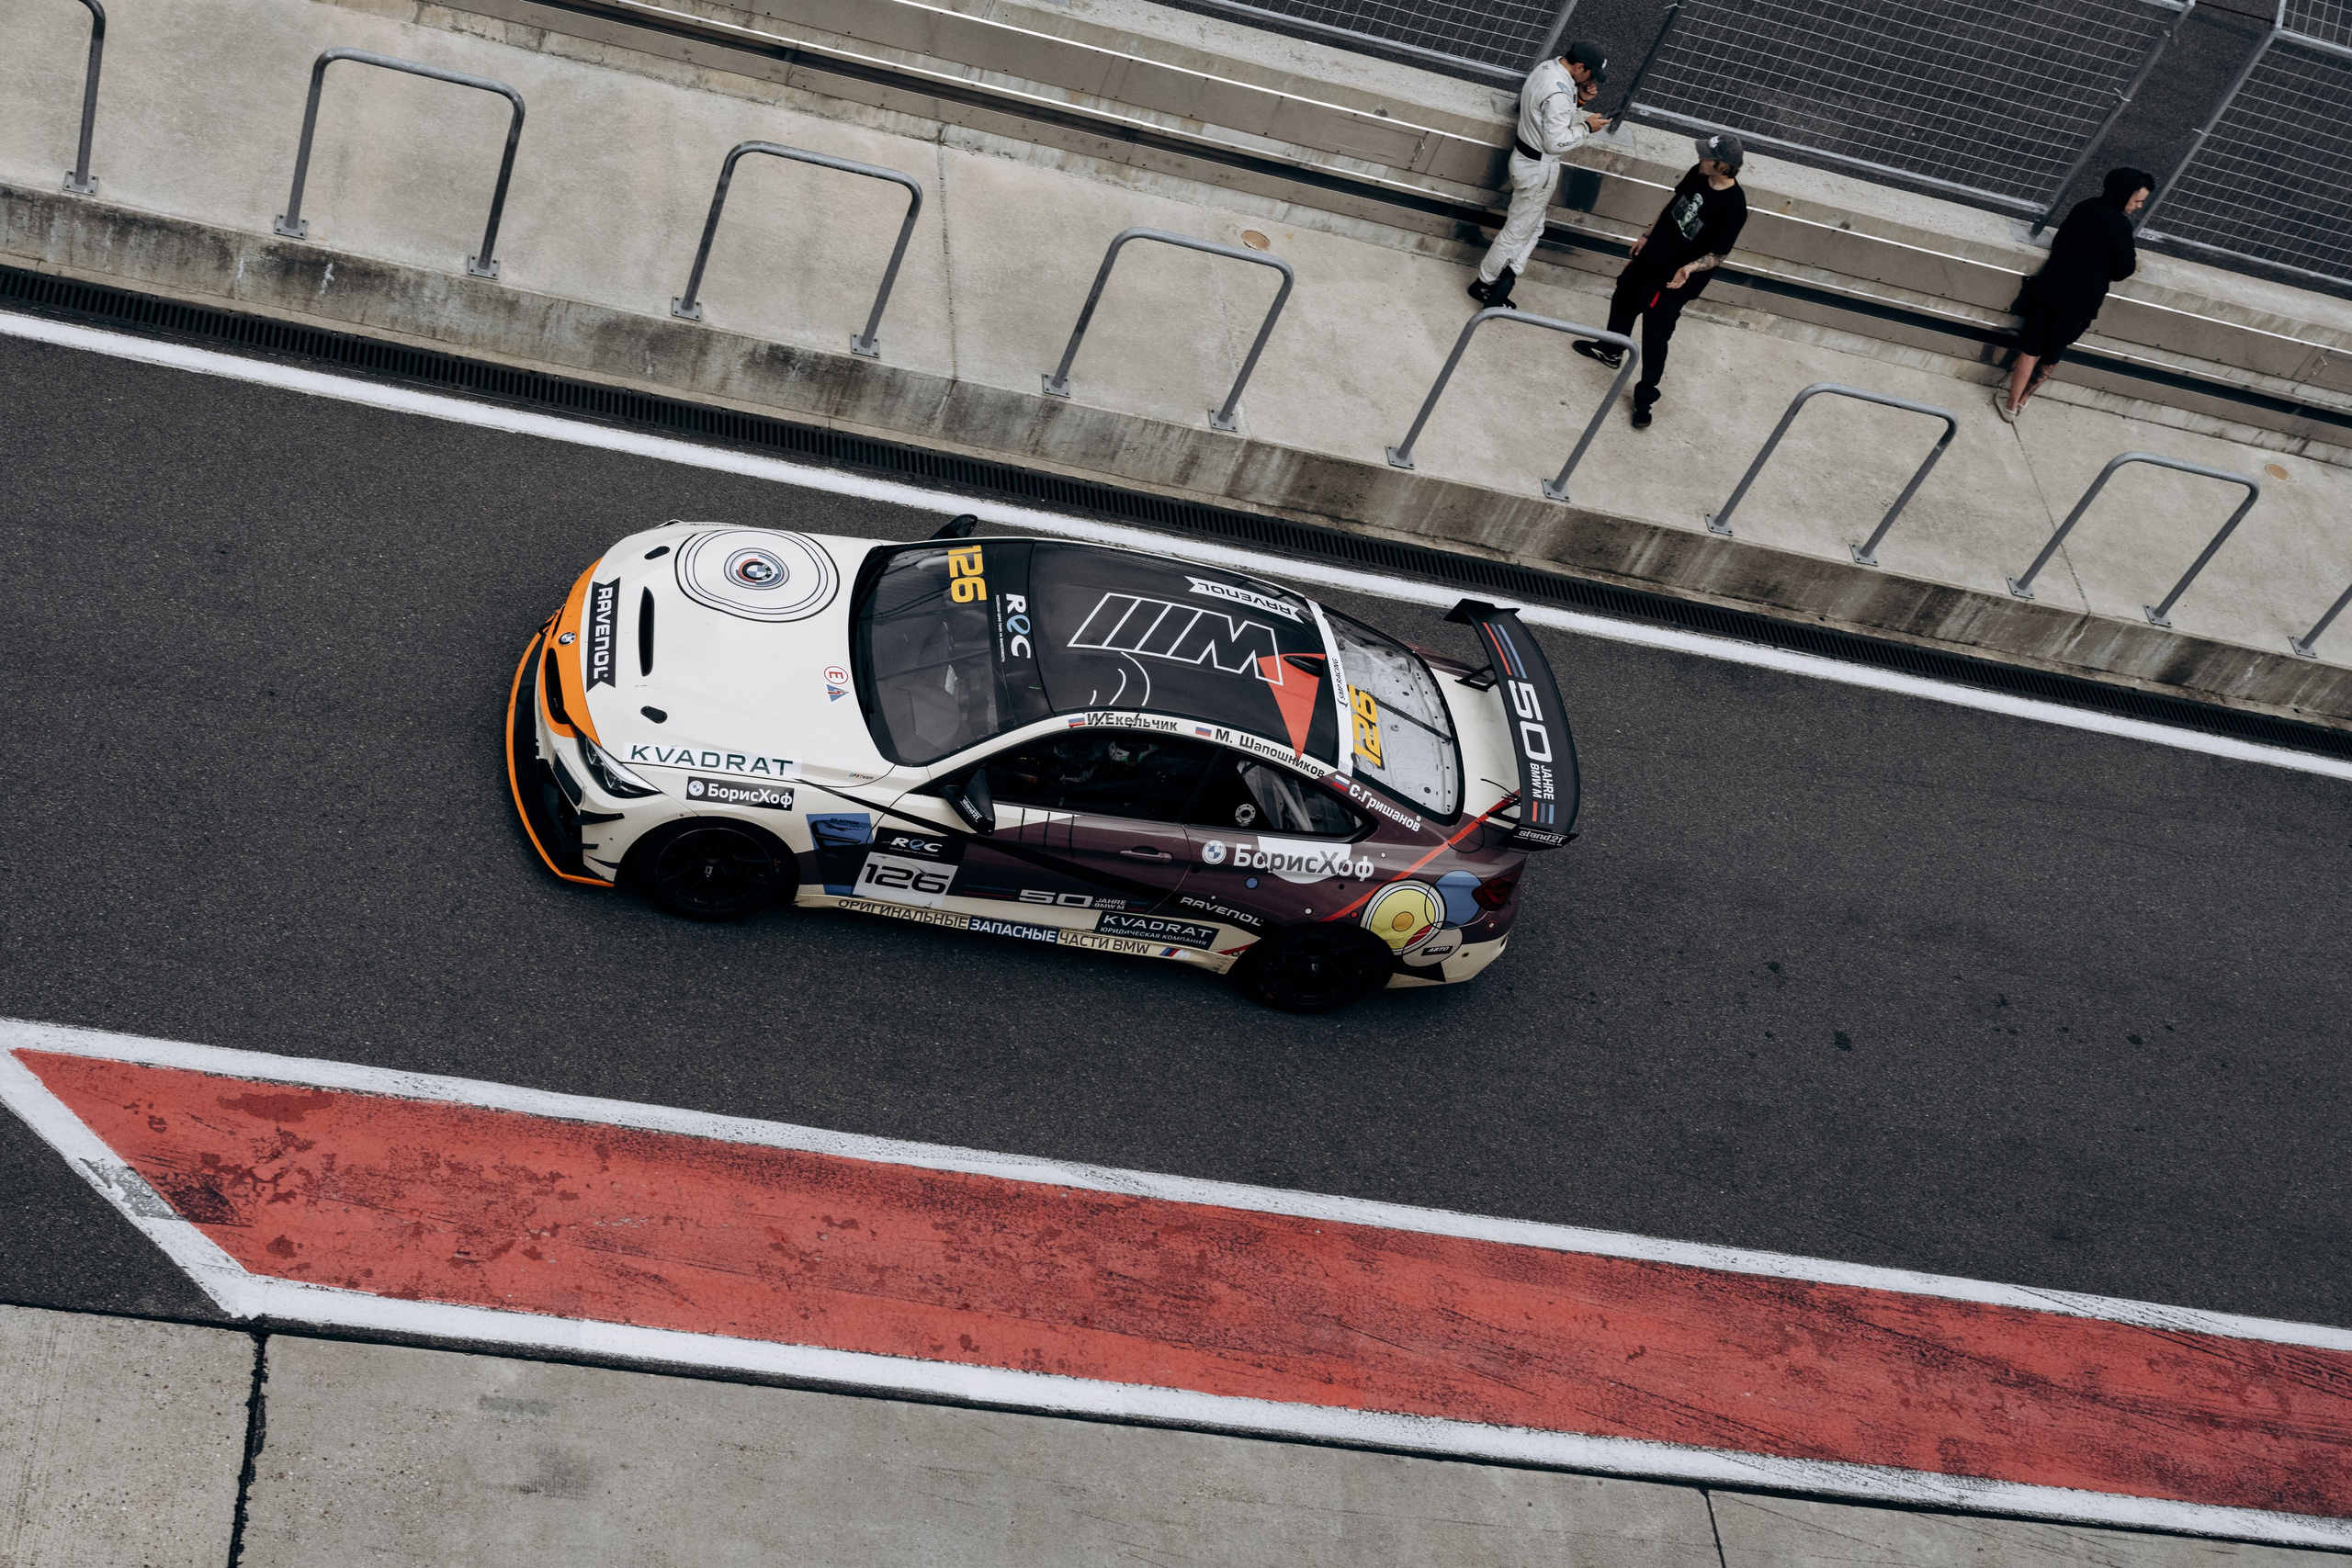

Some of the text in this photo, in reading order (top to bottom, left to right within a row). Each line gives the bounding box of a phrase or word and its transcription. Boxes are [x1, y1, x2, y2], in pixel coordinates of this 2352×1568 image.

[947, 545, 988, 604] 126
[1197, 581, 1292, 615] RAVENOL
[594, 586, 614, 680] RAVENOL
[828, 671, 844, 680] E
[1331, 657, 1346, 701] SMP RACING
[1348, 683, 1382, 768] 126
[1508, 679, 1553, 763] 50
[630, 744, 794, 776] KVADRAT
[1215, 728, 1233, 744] М.
[1239, 735, 1325, 779] Шапошников
[707, 783, 793, 808] БорисХоф
[1530, 762, 1543, 799] BMW M
[1540, 764, 1555, 801] JAHRE
[1349, 784, 1422, 832] С.Гришанов
[865, 863, 950, 895] 126
[1233, 842, 1374, 882] БорисХоф
[1018, 888, 1093, 908] 50
[1180, 896, 1261, 927] RAVENOL
[838, 898, 1150, 954] ОРИГИНАЛЬНЫЕ ЗАПАСНЫЕ ЧАСТИ BMW
[1100, 926, 1207, 946] ЮРИДИЧЕСКАЯ КОМПАНИЯ
[1102, 914, 1213, 938] KVADRAT
